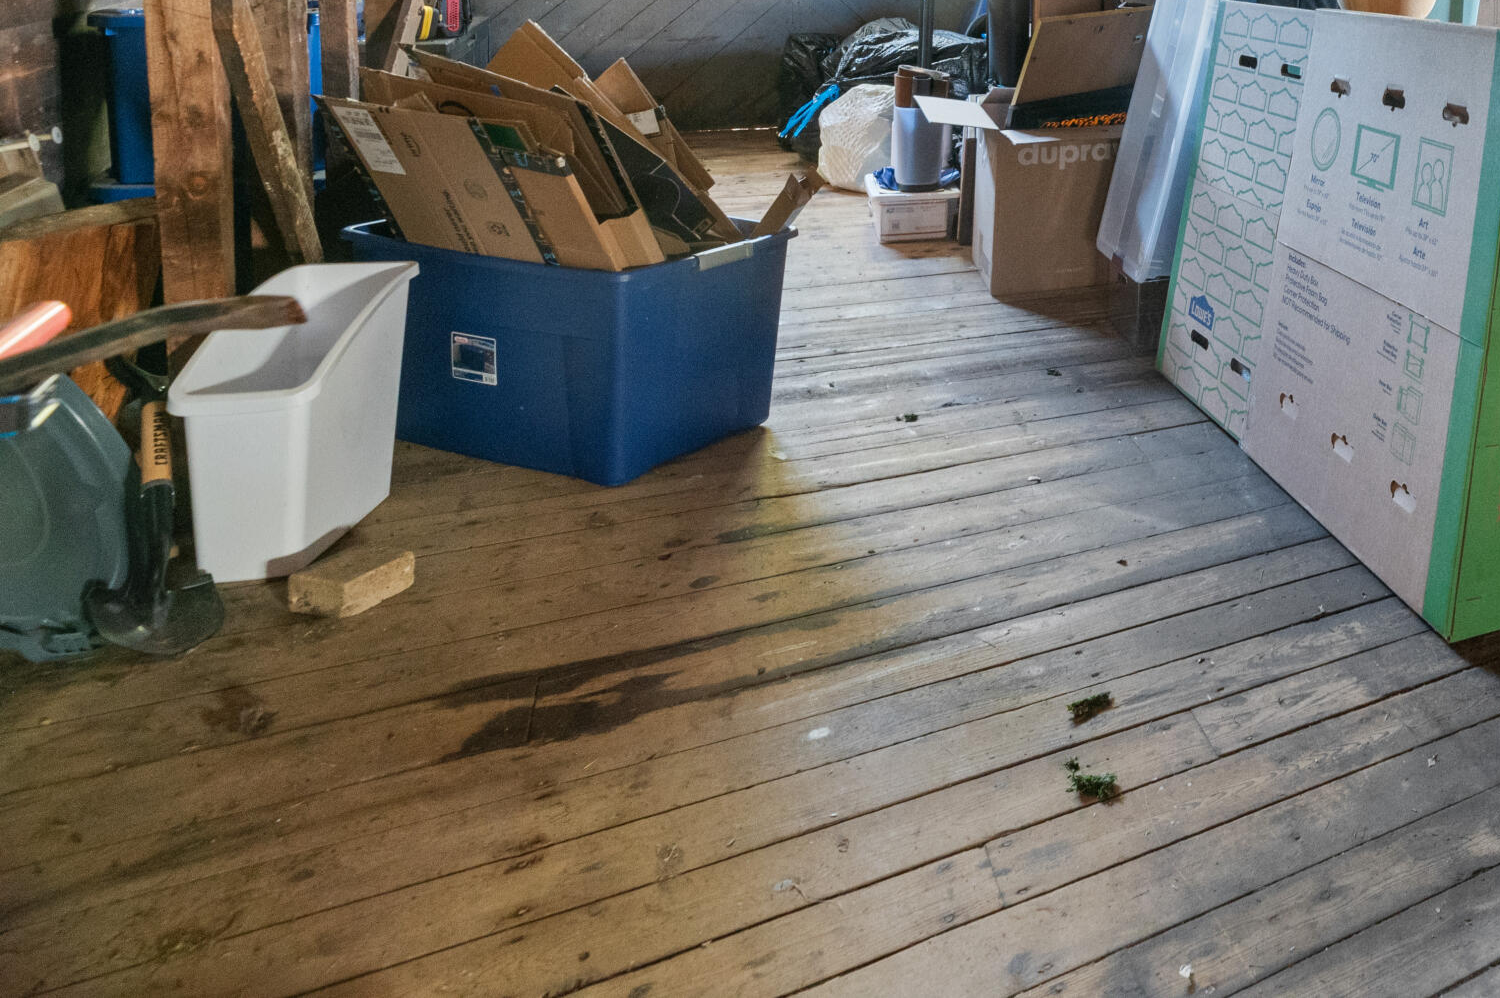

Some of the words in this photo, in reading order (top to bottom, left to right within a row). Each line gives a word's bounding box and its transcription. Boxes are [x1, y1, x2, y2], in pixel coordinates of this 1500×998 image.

[1356, 192, 1382, 210] Television
[1418, 218, 1430, 231] Art
[1413, 247, 1426, 260] Arte
[1310, 276, 1319, 286] Box
[1319, 291, 1328, 306] Bag
[1192, 300, 1212, 326] LOWE'S
[153, 411, 170, 465] CRAFTSMAN
